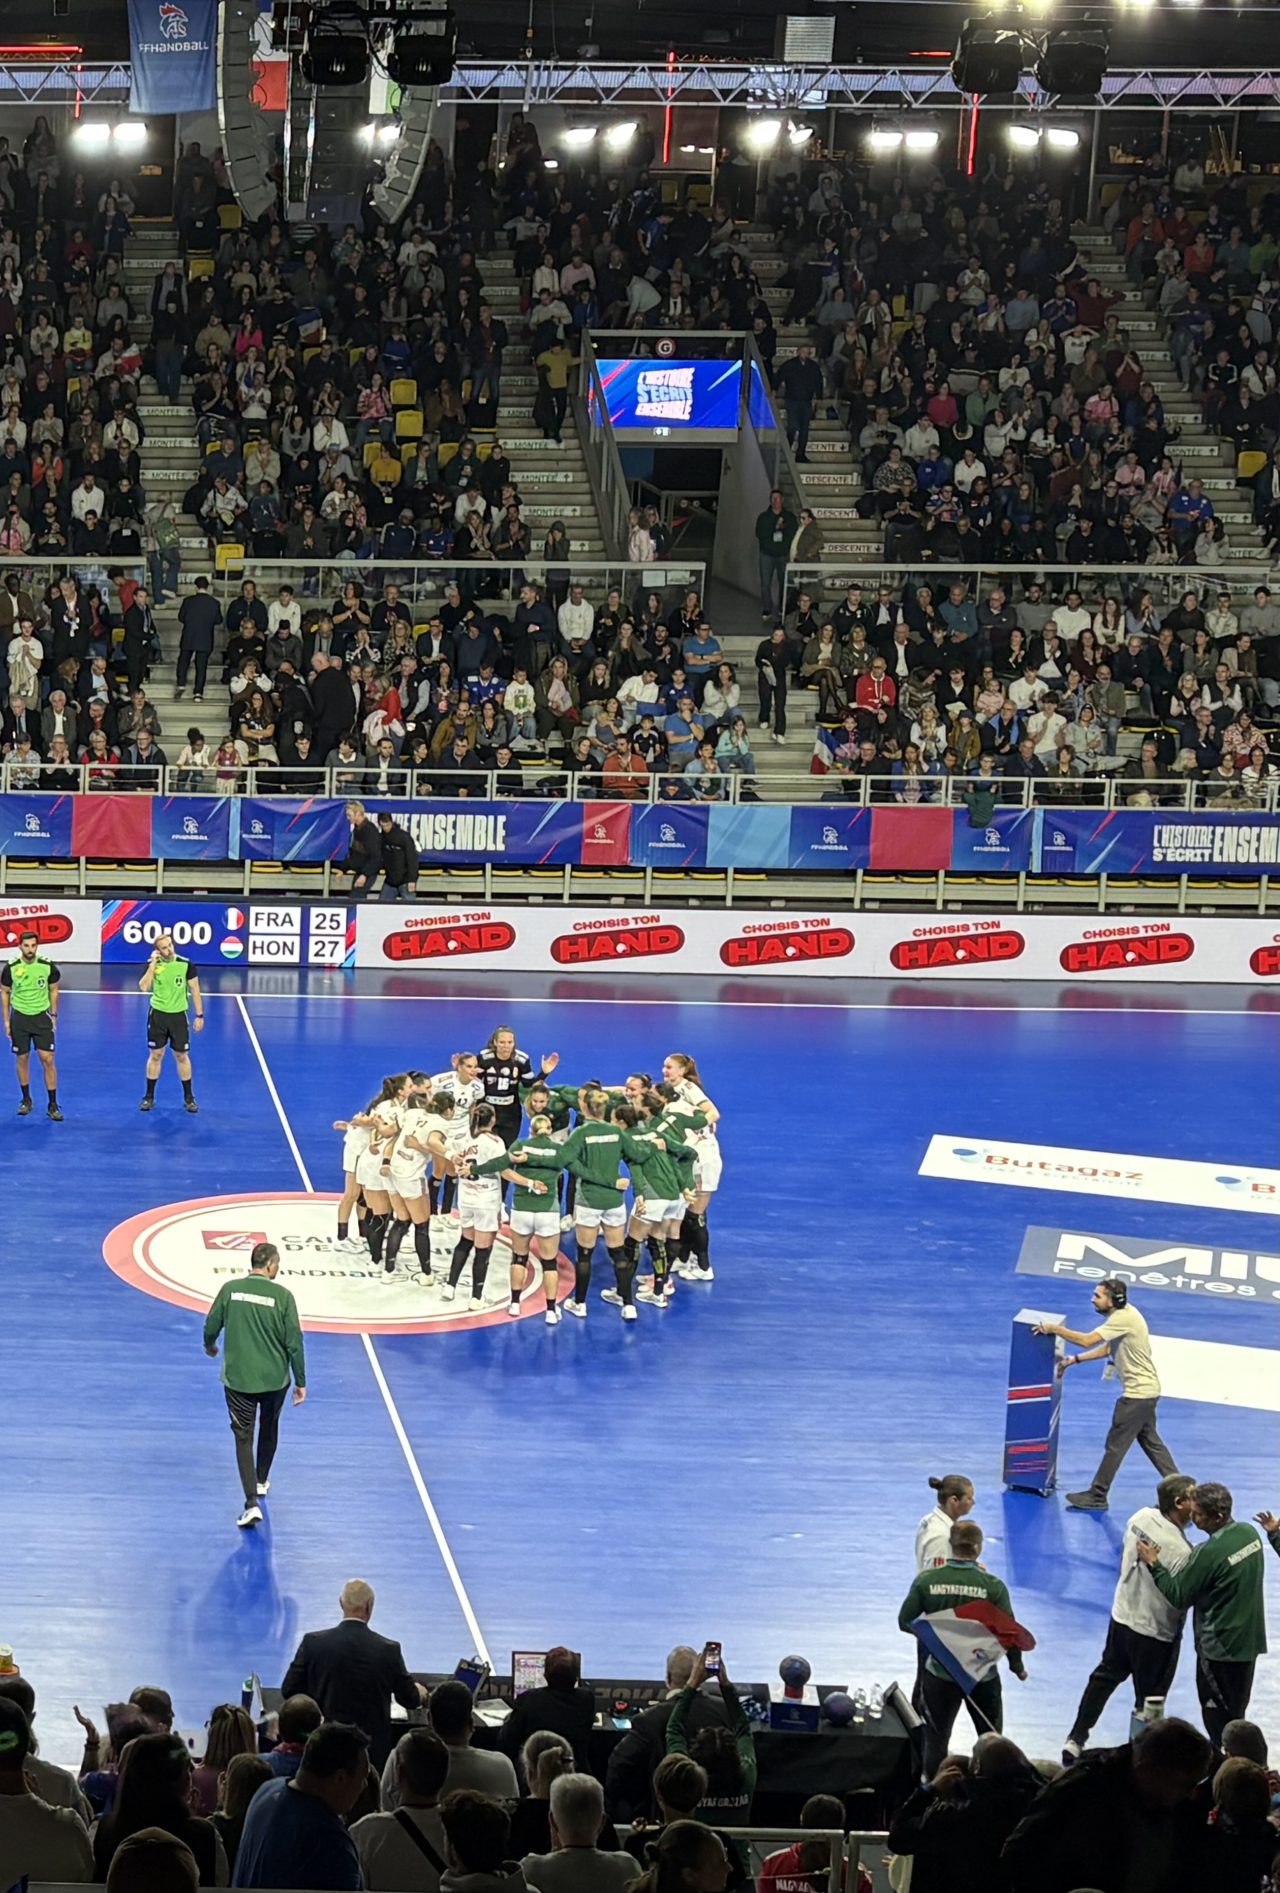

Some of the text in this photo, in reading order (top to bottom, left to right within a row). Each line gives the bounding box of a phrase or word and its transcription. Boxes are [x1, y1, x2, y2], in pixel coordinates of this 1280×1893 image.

[828, 544, 872, 553] DESCENTE
[410, 813, 507, 851] ENSEMBLE
[1153, 824, 1214, 848] L'HISTOIRE
[1152, 847, 1213, 862] S'ÉCRIT
[22, 905, 48, 915] TON
[405, 912, 491, 928] CHOISIS TON
[254, 912, 341, 930] FRA 25
[572, 916, 661, 931] CHOISIS TON
[742, 918, 831, 935] CHOISIS TON
[912, 921, 1002, 938] CHOISIS TON
[123, 920, 212, 944] 60:00
[391, 926, 511, 958] HAND
[1082, 923, 1171, 941] CHOISIS TON
[252, 940, 341, 957] HON 27
[559, 929, 680, 960] HAND
[728, 932, 851, 963] HAND
[899, 935, 1020, 967] HAND
[1068, 938, 1190, 969] HAND
[984, 1154, 1144, 1181] Butagaz
[1053, 1261, 1257, 1298] Fenêtres
